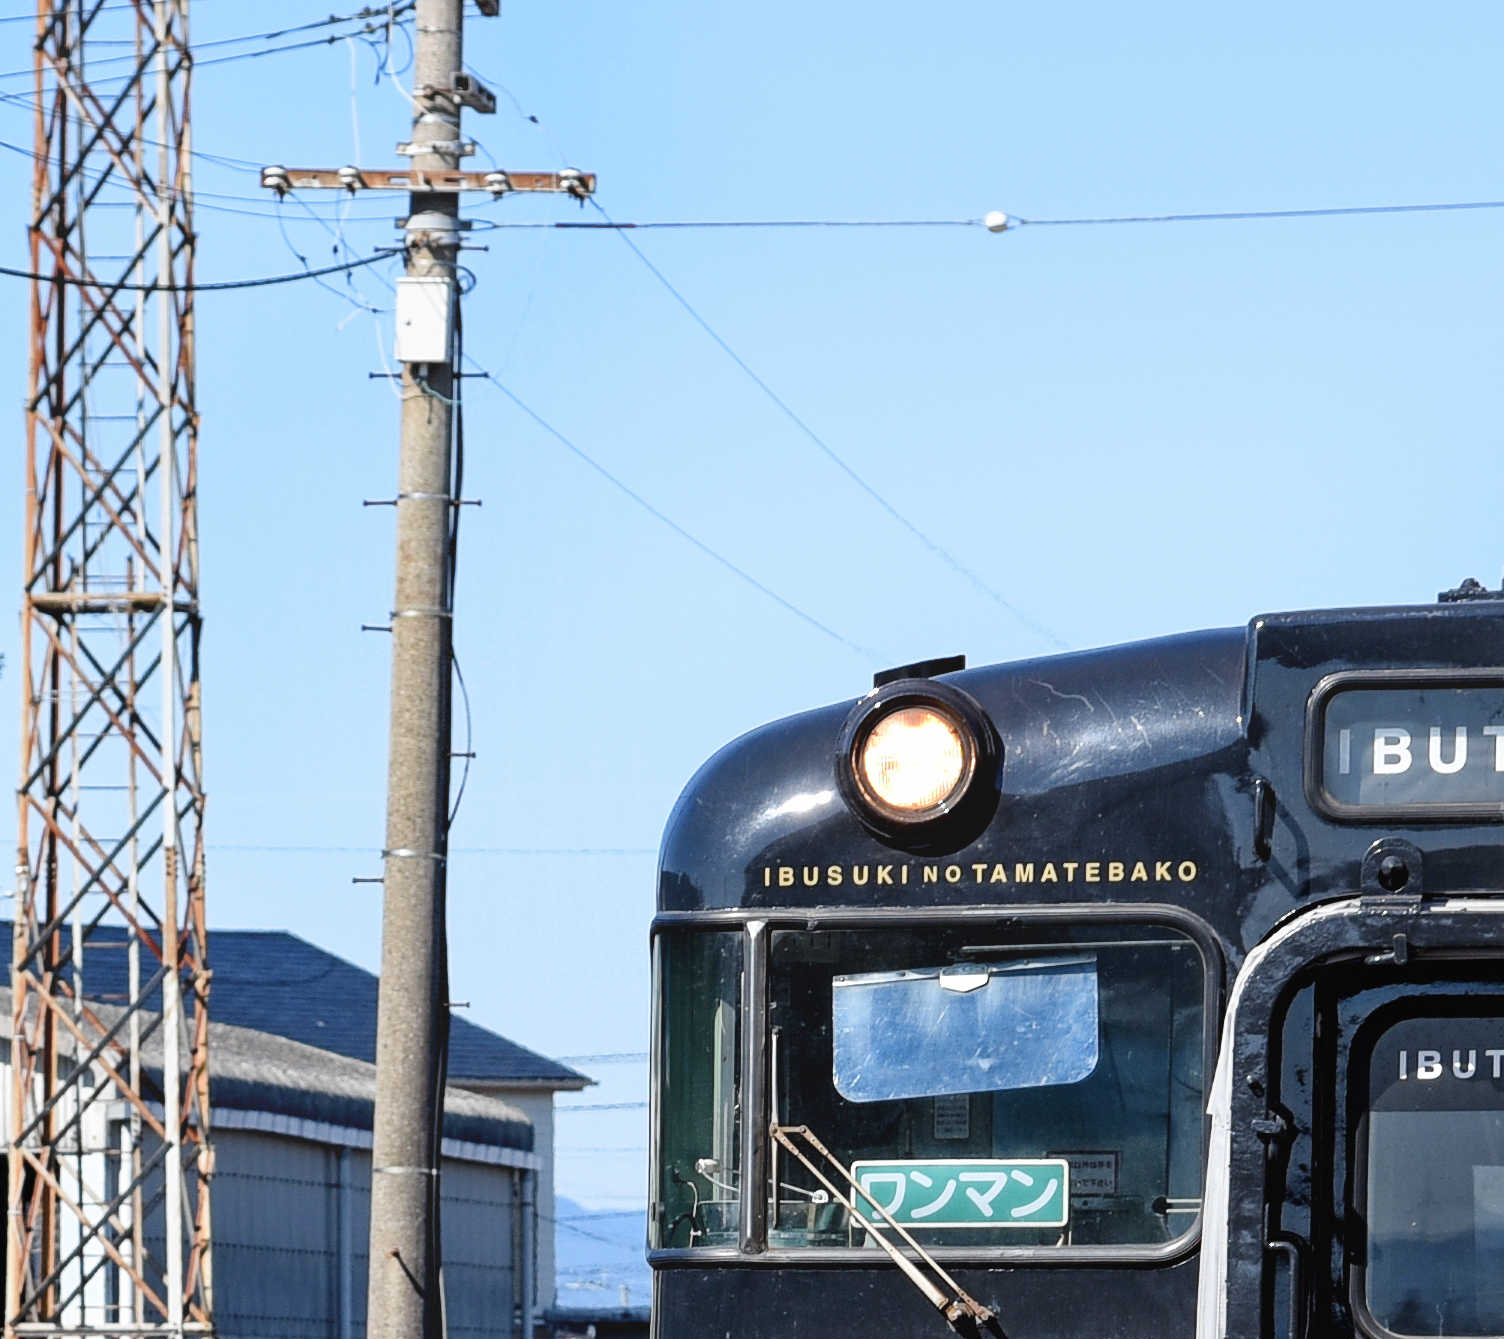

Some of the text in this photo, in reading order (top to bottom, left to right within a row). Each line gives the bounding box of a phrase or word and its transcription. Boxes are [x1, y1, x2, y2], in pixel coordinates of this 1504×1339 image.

[764, 862, 1199, 888] IBUSUKI NO TAMATEBAKO
[859, 1169, 1058, 1223] ワンマン
